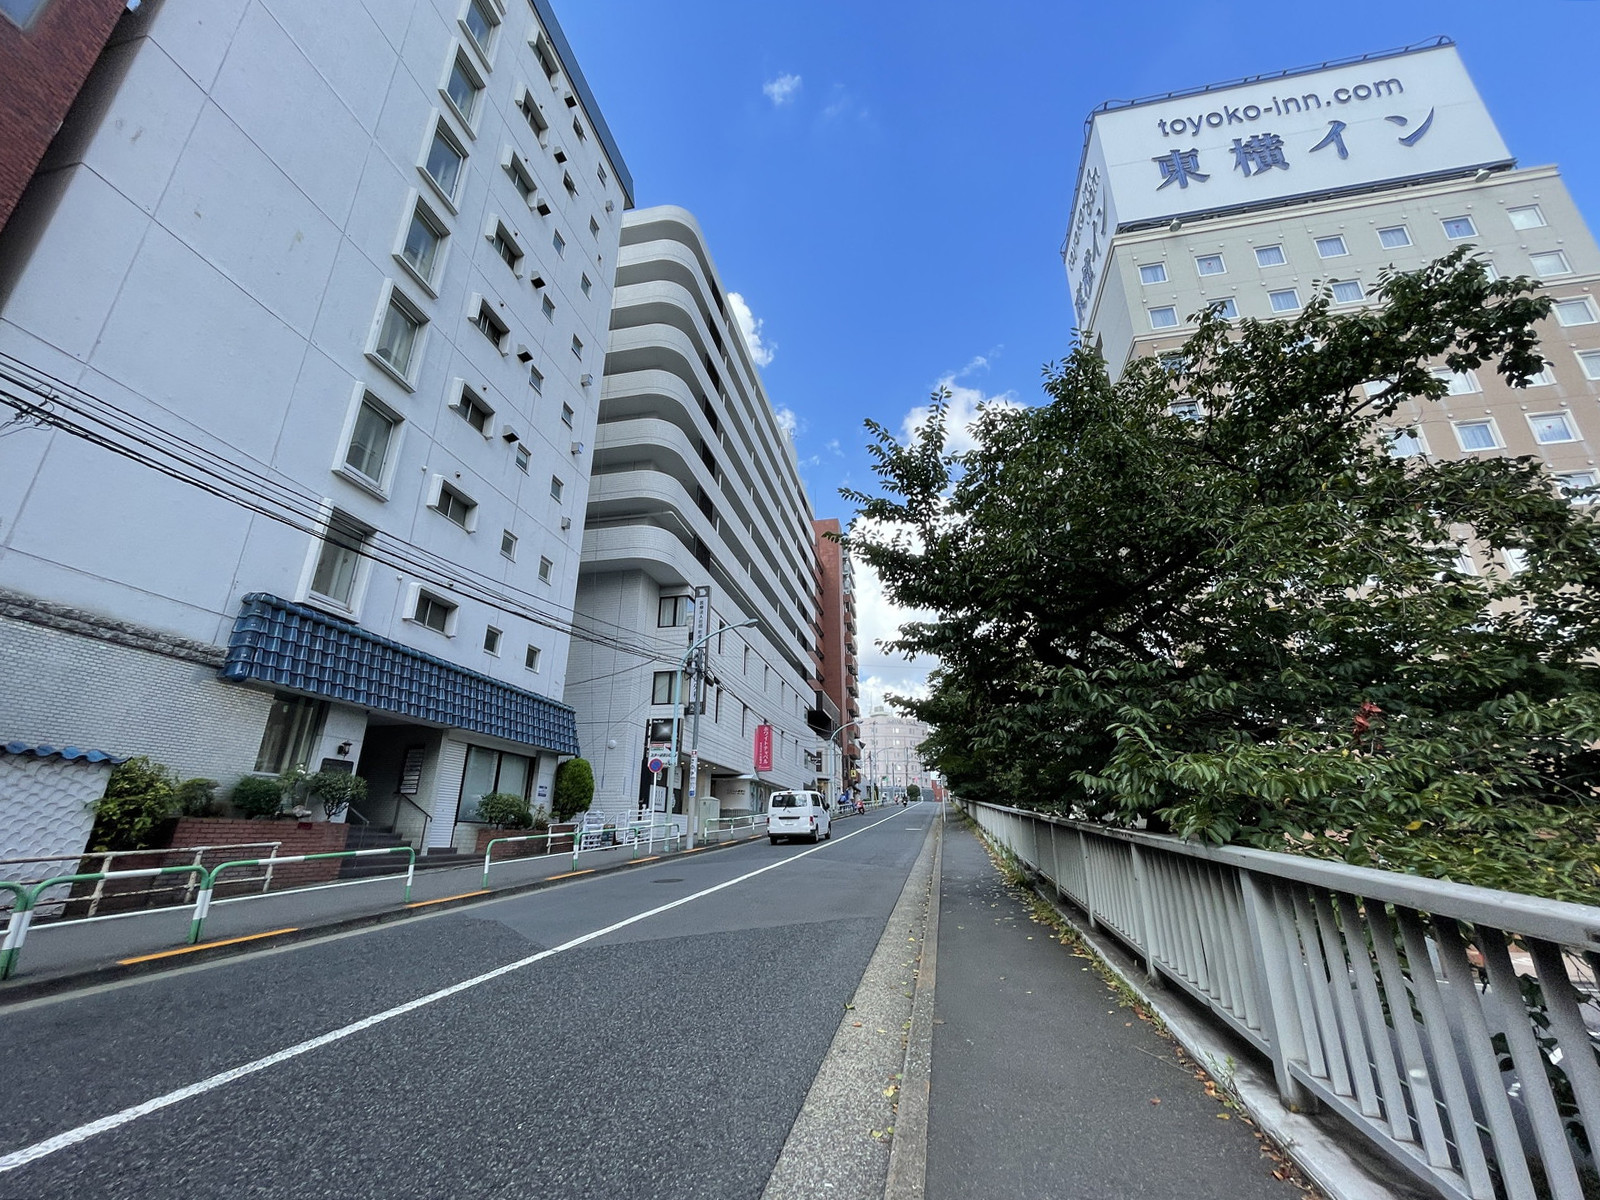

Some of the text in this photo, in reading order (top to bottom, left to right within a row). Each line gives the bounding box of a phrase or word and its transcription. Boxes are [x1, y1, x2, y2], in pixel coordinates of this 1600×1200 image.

[1157, 75, 1404, 136] toyoko-inn.com
[1151, 106, 1435, 191] 東横イン
